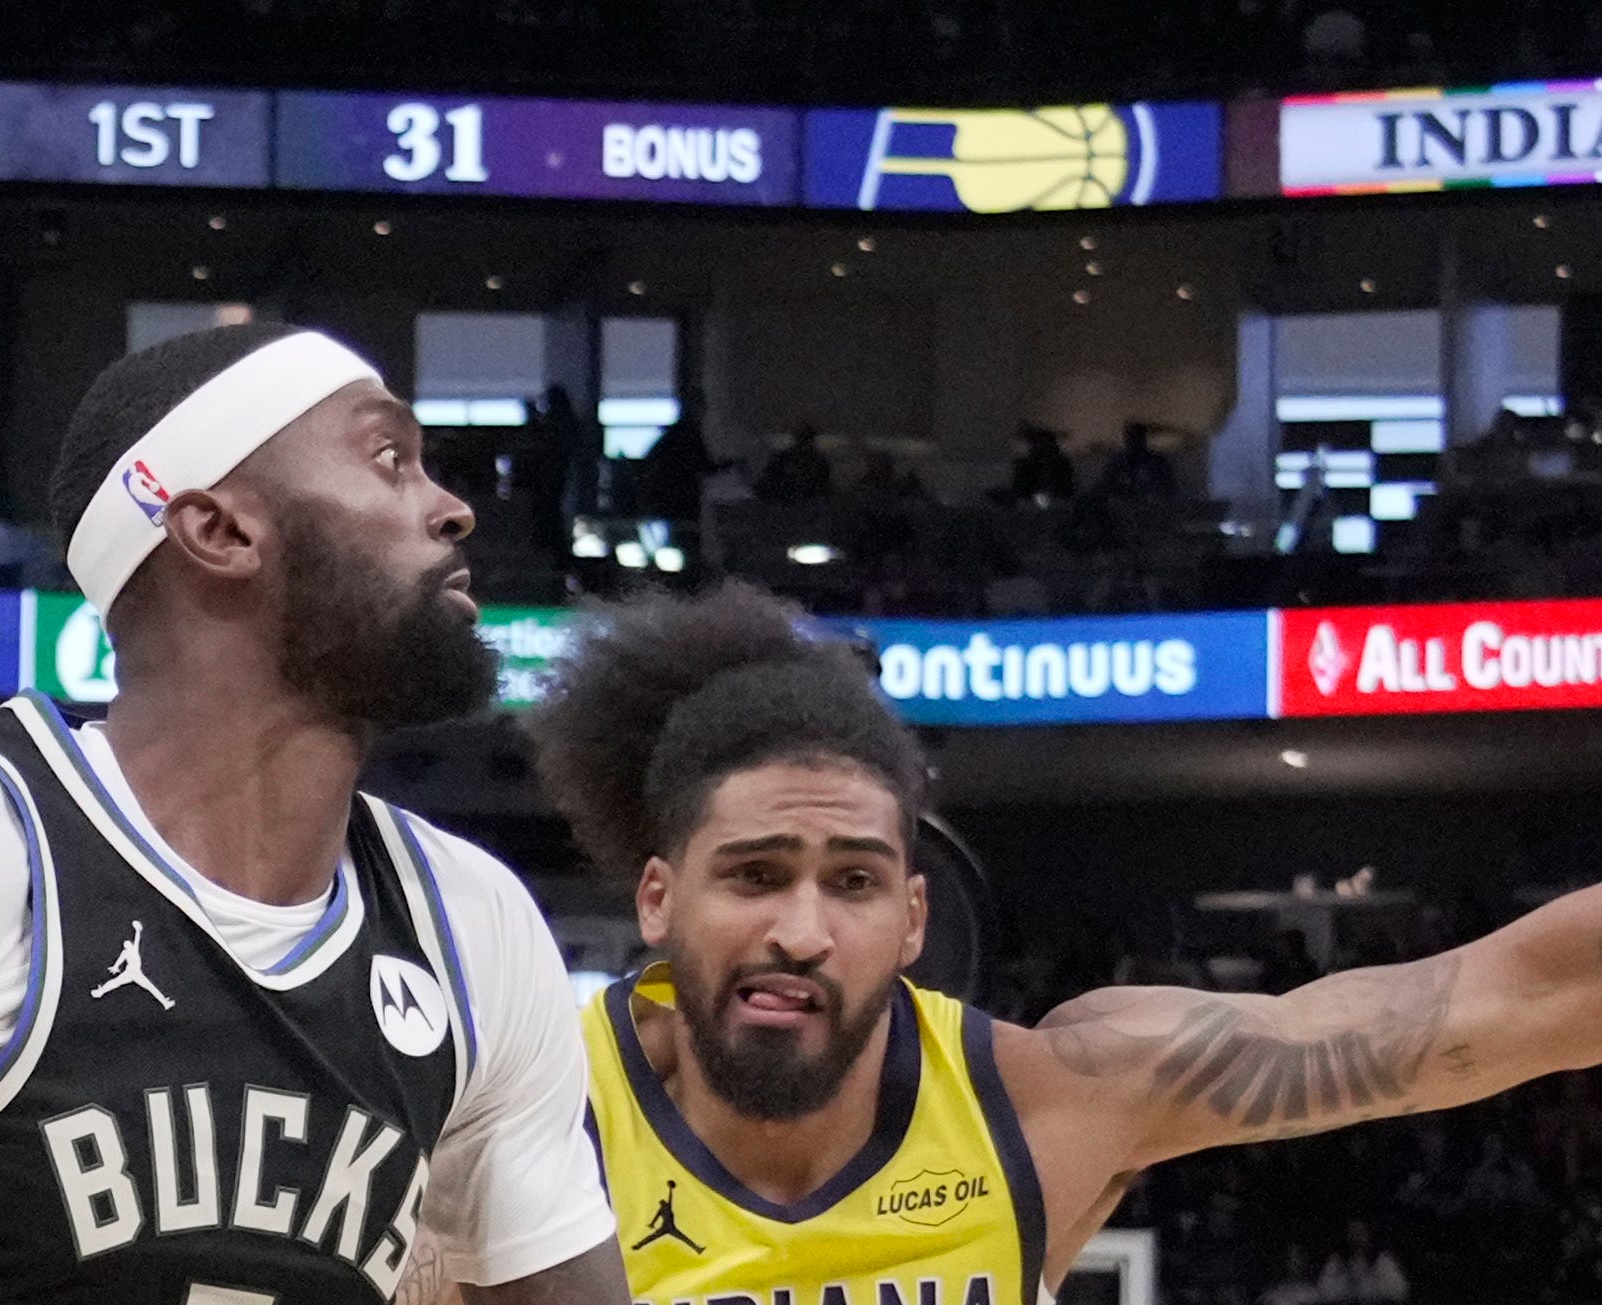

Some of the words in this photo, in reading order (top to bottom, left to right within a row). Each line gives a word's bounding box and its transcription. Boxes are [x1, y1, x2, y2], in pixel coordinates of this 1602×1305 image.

[89, 101, 215, 169] 1ST
[382, 104, 489, 182] 31
[602, 123, 762, 184] BONUS
[878, 631, 1196, 701] ontinuus
[1356, 624, 1456, 693] ALL
[877, 1184, 948, 1215] LUCAS
[954, 1175, 989, 1202] OIL
